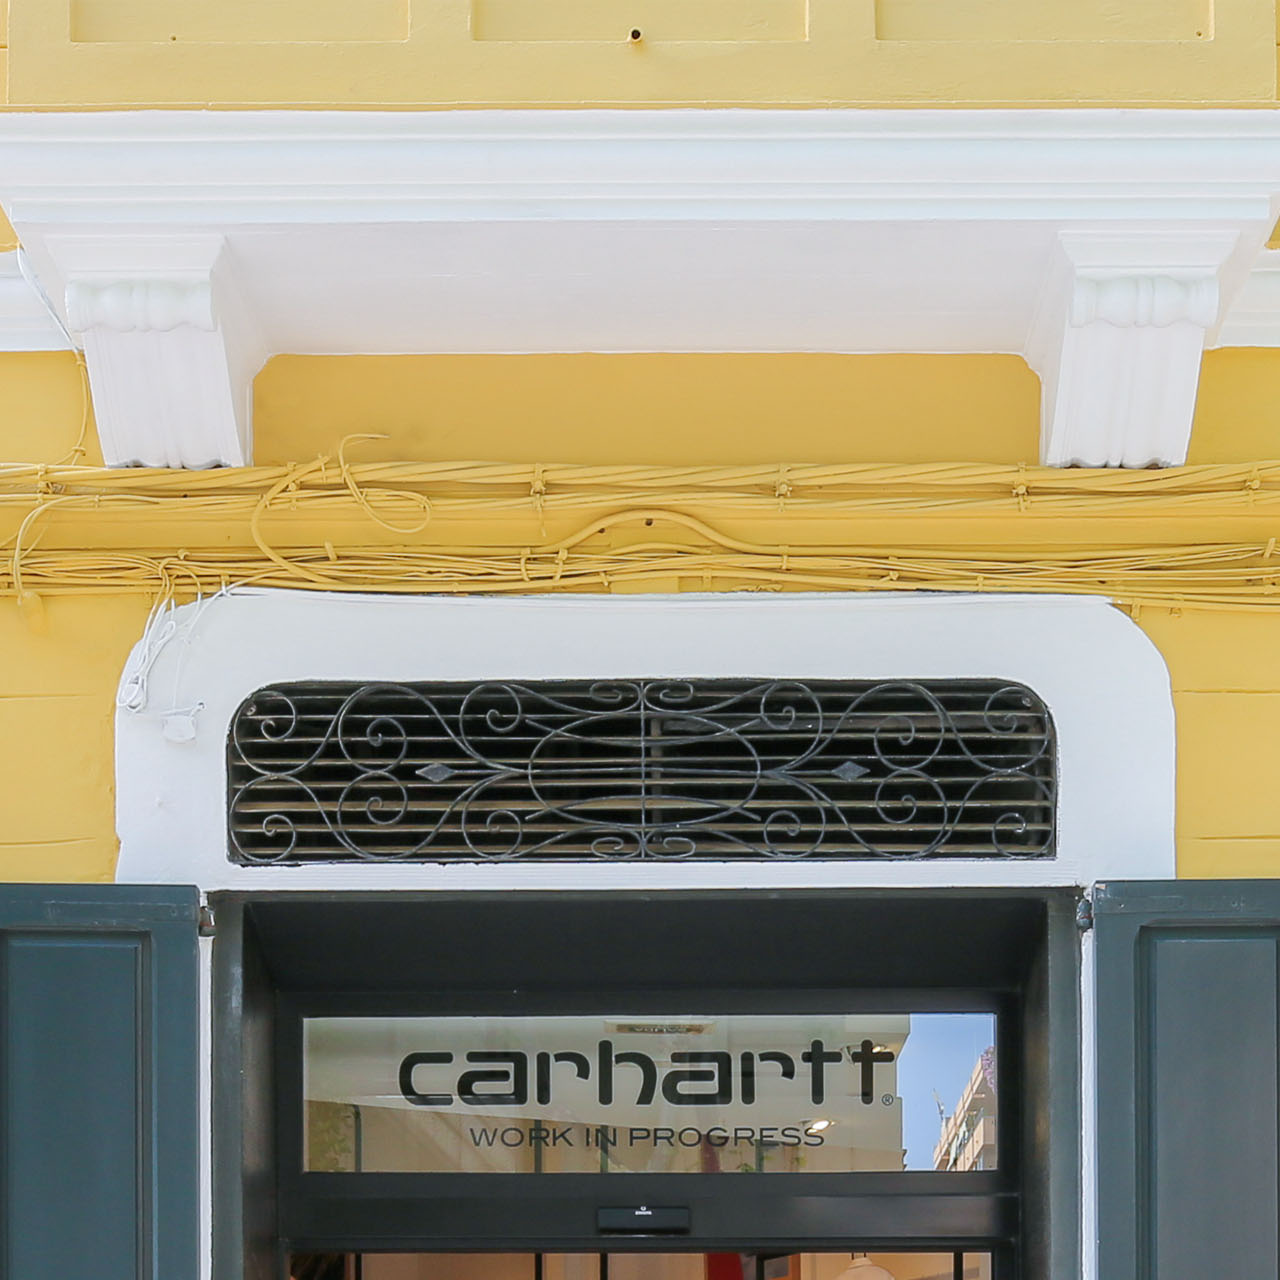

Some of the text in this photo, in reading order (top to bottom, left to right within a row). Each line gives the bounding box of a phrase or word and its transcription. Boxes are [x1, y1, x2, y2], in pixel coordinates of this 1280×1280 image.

[398, 1039, 895, 1106] carhartt
[470, 1127, 825, 1147] WORK IN PROGRESS
